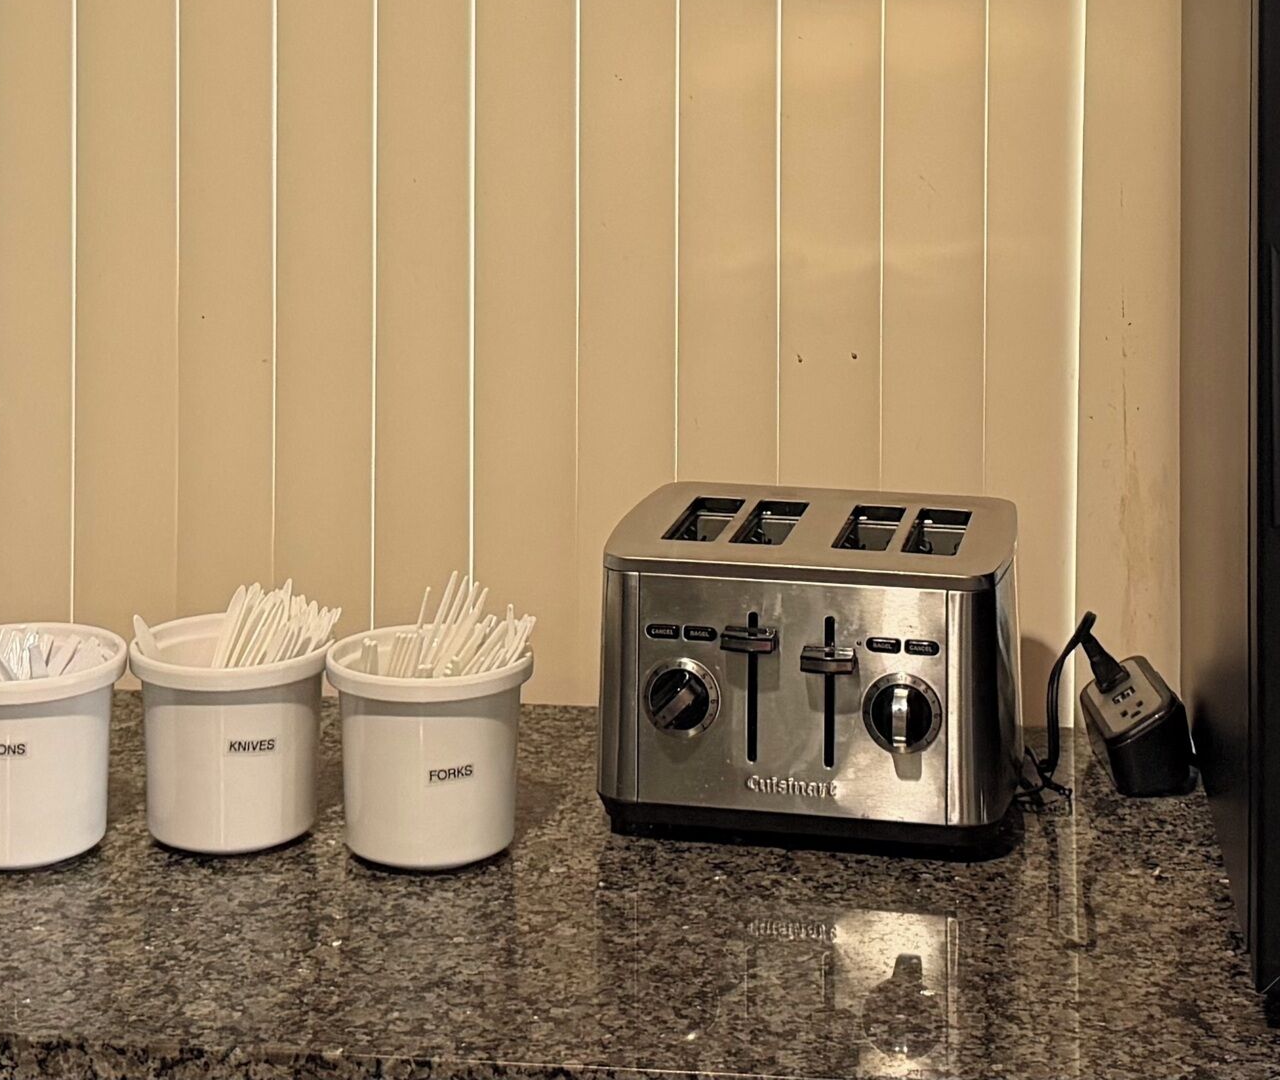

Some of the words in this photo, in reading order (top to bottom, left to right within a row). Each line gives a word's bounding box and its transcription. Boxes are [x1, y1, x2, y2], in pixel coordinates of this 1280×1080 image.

[689, 630, 710, 638] BAGEL
[872, 642, 892, 650] BAGEL
[909, 645, 933, 653] CANCEL
[229, 739, 275, 752] KNIVES
[429, 764, 473, 782] FORKS
[745, 774, 838, 799] Cuisinart
